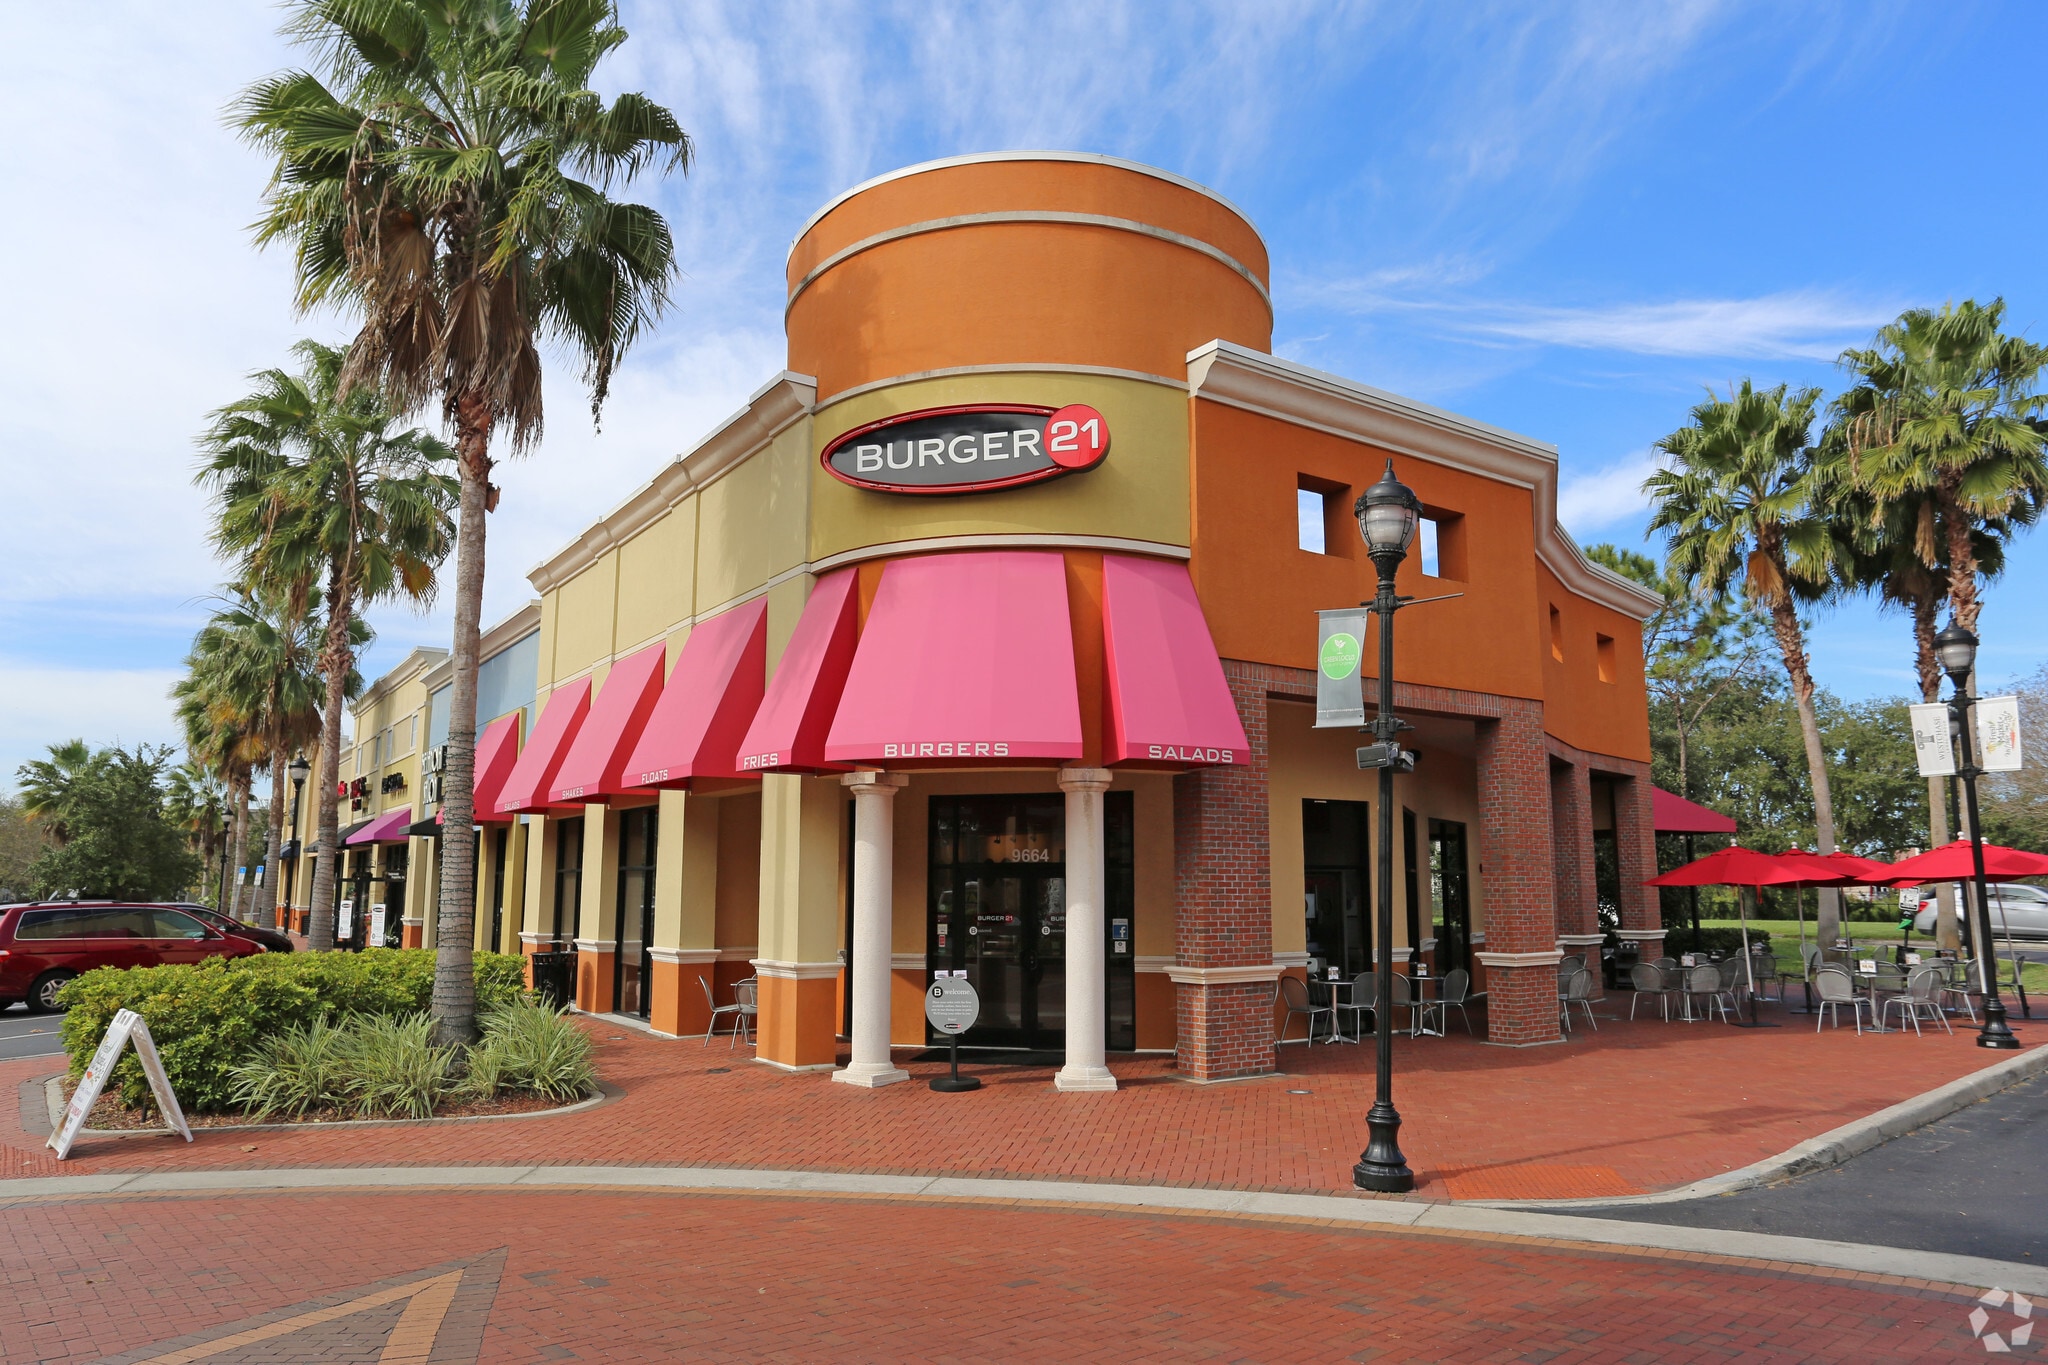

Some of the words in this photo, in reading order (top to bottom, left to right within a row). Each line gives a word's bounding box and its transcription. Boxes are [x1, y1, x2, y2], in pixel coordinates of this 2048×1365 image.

[856, 429, 1041, 473] BURGER
[1051, 418, 1099, 452] 21
[1934, 716, 1945, 761] WESTCHASE
[884, 742, 1009, 757] BURGERS
[1148, 745, 1233, 763] SALADS
[743, 753, 778, 769] FRIES
[641, 769, 668, 784] FLOATS
[562, 787, 584, 800] SHAKES
[504, 800, 520, 811] SALADS
[1012, 848, 1049, 862] 9664
